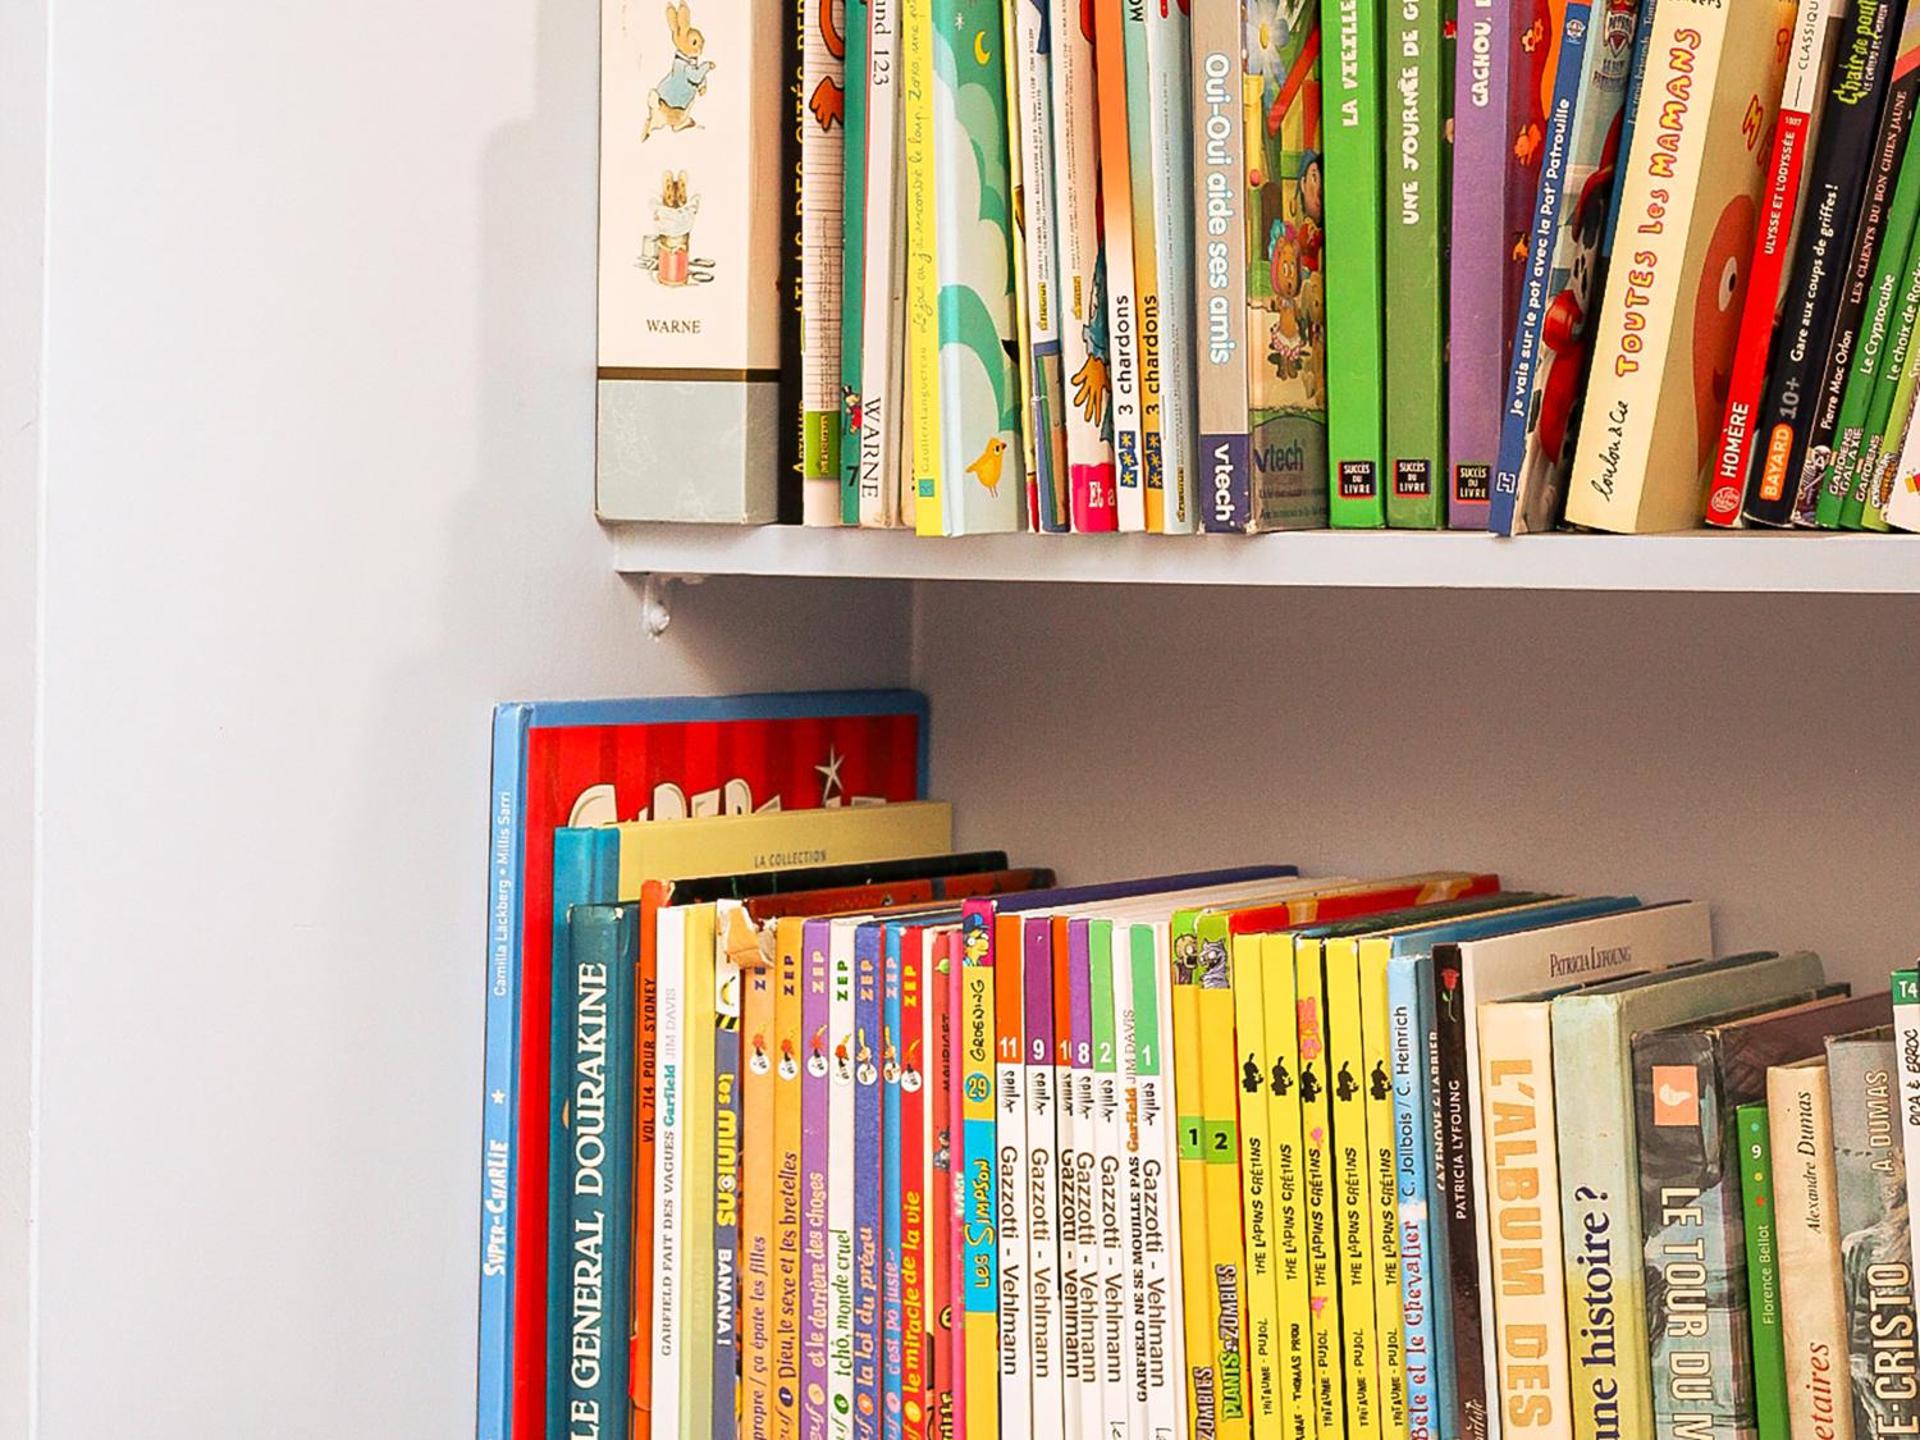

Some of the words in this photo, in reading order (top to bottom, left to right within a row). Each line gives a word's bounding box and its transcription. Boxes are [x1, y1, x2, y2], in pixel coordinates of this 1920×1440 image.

[1340, 0, 1359, 88] VIEILLE
[1402, 28, 1420, 56] DE
[873, 50, 890, 86] 123
[1205, 54, 1234, 167] Oui-Oui
[1341, 98, 1359, 127] LA
[1397, 65, 1420, 171] JOURNÉE
[1647, 28, 1702, 178] MAMANS
[1889, 90, 1907, 132] JAUNE
[1545, 98, 1571, 178] Patrouille
[1880, 132, 1897, 172] CHIEN
[1205, 173, 1234, 236] aide
[1402, 181, 1420, 225] UNE
[1637, 189, 1669, 234] Les
[1763, 211, 1781, 255] ULYSSE
[1773, 131, 1796, 192] L'ODYSSÉE
[1874, 173, 1887, 202] BON
[1535, 219, 1552, 235] la
[1207, 242, 1232, 289] ses
[1531, 238, 1549, 277] avec
[1857, 226, 1877, 279] CLIENTS
[1525, 279, 1543, 308] pot
[1805, 259, 1825, 299] coups
[1850, 280, 1863, 305] LES
[646, 319, 701, 334] WARNE
[1209, 297, 1237, 365] amis
[1522, 311, 1536, 327] le
[1615, 251, 1657, 377] TOUTES
[1800, 301, 1815, 326] aux
[1863, 274, 1895, 356] Cryptocube
[1112, 296, 1132, 394] chardons
[1141, 296, 1159, 394] chardons
[1521, 329, 1534, 358] sur
[1789, 329, 1808, 362] Gare
[1890, 325, 1911, 364] choix
[1514, 362, 1530, 395] vais
[1820, 396, 1839, 431] Pierre
[1835, 329, 1853, 364] Orlan
[1118, 404, 1133, 415] 3
[862, 396, 881, 498] WARNE
[1719, 401, 1749, 478] HOMÈRE
[1762, 427, 1789, 498] BAYARD
[1214, 443, 1236, 522] vtech
[1344, 483, 1370, 494] LIVRE
[1399, 482, 1425, 493] LIVRE
[1459, 487, 1486, 498] LIVRE
[1590, 439, 1621, 502] loulou
[497, 791, 511, 825] Sarri
[496, 828, 510, 865] Millis
[768, 850, 828, 866] COLLECTION
[493, 945, 508, 997] Camilla
[783, 955, 795, 997] ZEP
[812, 949, 825, 995] ZEP
[837, 960, 849, 1002] ZEP
[860, 959, 874, 1002] ZEP
[885, 956, 898, 999] ZEP
[904, 964, 917, 1008] ZEP
[1899, 979, 1919, 998] T4
[643, 978, 656, 1032] SYDNEY
[664, 987, 677, 1031] DAVIS
[971, 979, 987, 1063] GROENING
[664, 1035, 676, 1058] JIM
[998, 1036, 1018, 1059] 11
[1032, 1038, 1046, 1060] 9
[1077, 1042, 1091, 1064] 8
[1099, 1041, 1112, 1063] 2
[1123, 1008, 1135, 1054] DAVIS
[1393, 1007, 1409, 1075] Heinrich
[573, 962, 609, 1198] DOURAKINE
[643, 1040, 656, 1078] POUR
[643, 1086, 656, 1109] 714
[662, 1064, 676, 1127] Garfield
[1125, 1087, 1139, 1153] Garfield
[1448, 1079, 1464, 1150] LYFOUNG
[1863, 1070, 1892, 1147] DUMAS
[643, 1117, 656, 1143] VOL
[1214, 1132, 1228, 1151] 2
[1796, 1091, 1816, 1157] Dumas
[663, 1132, 676, 1198] VAGUES
[716, 1110, 737, 1227] MINIONS
[778, 1152, 797, 1226] bretelles
[1129, 1156, 1140, 1188] PAS
[1247, 1137, 1264, 1196] CRÉTINS
[1279, 1144, 1295, 1201] CRÉTINS
[1308, 1149, 1324, 1207] CRÉTINS
[1343, 1147, 1361, 1206] CRÉTINS
[1379, 1149, 1394, 1207] CRÉTINS
[1452, 1155, 1468, 1219] PATRICIA
[1491, 1060, 1546, 1296] L'ALBUM
[663, 1199, 674, 1230] DES
[805, 1172, 826, 1228] choses
[905, 1191, 921, 1224] vie
[963, 1160, 995, 1247] SIMPSON
[1001, 1146, 1019, 1239] Gazzotti
[1030, 1147, 1049, 1241] Gazzotti
[1076, 1152, 1096, 1245] Gazzotti
[1100, 1155, 1121, 1249] Gazzotti
[1143, 1159, 1163, 1253] Gazzotti
[1660, 1187, 1704, 1227] LE
[1800, 1162, 1821, 1235] Alexandre
[805, 1230, 824, 1260] des
[1130, 1192, 1144, 1266] MOUILLE
[1251, 1200, 1266, 1248] LAPINS
[1282, 1206, 1298, 1254] LAPINS
[1310, 1211, 1327, 1260] LAPINS
[1347, 1210, 1363, 1259] LAPINS
[1381, 1210, 1396, 1259] LAPINS
[1757, 1225, 1771, 1263] Bellot
[662, 1235, 674, 1271] FAIT
[749, 1236, 768, 1277] filles
[829, 1229, 849, 1271] cruel
[859, 1225, 877, 1291] préau
[901, 1256, 918, 1284] de
[1254, 1252, 1267, 1276] THE
[1285, 1257, 1298, 1281] THE
[1314, 1262, 1327, 1287] THE
[1350, 1262, 1363, 1287] THE
[1384, 1262, 1398, 1286] THE
[1401, 1220, 1423, 1326] Chevalier
[571, 1211, 606, 1389] GENERAL
[717, 1249, 733, 1334] BANANA
[782, 1278, 797, 1316] sexe
[806, 1263, 827, 1329] derrière
[833, 1275, 851, 1330] monde
[856, 1297, 874, 1325] du
[1214, 1263, 1240, 1340] ZOMBIES
[1577, 1212, 1617, 1367] histoire
[1663, 1238, 1709, 1338] TOUR
[1760, 1267, 1775, 1325] Florence
[660, 1276, 673, 1357] GARFIELD
[750, 1308, 767, 1350] épate
[903, 1287, 923, 1369] miracle
[1002, 1264, 1020, 1376] Vehlmann
[1033, 1267, 1051, 1378] Vehlmann
[1079, 1271, 1099, 1384] Vehlmann
[1104, 1273, 1124, 1384] Vehlmann
[1147, 1277, 1166, 1387] Vehlmann
[777, 1336, 797, 1379] Dieu,
[1136, 1320, 1148, 1402] GARFIELD
[1505, 1323, 1552, 1428] DES
[1668, 1351, 1714, 1402] DU
[1219, 1351, 1244, 1419] PLANTS
[571, 1401, 600, 1440] LE
